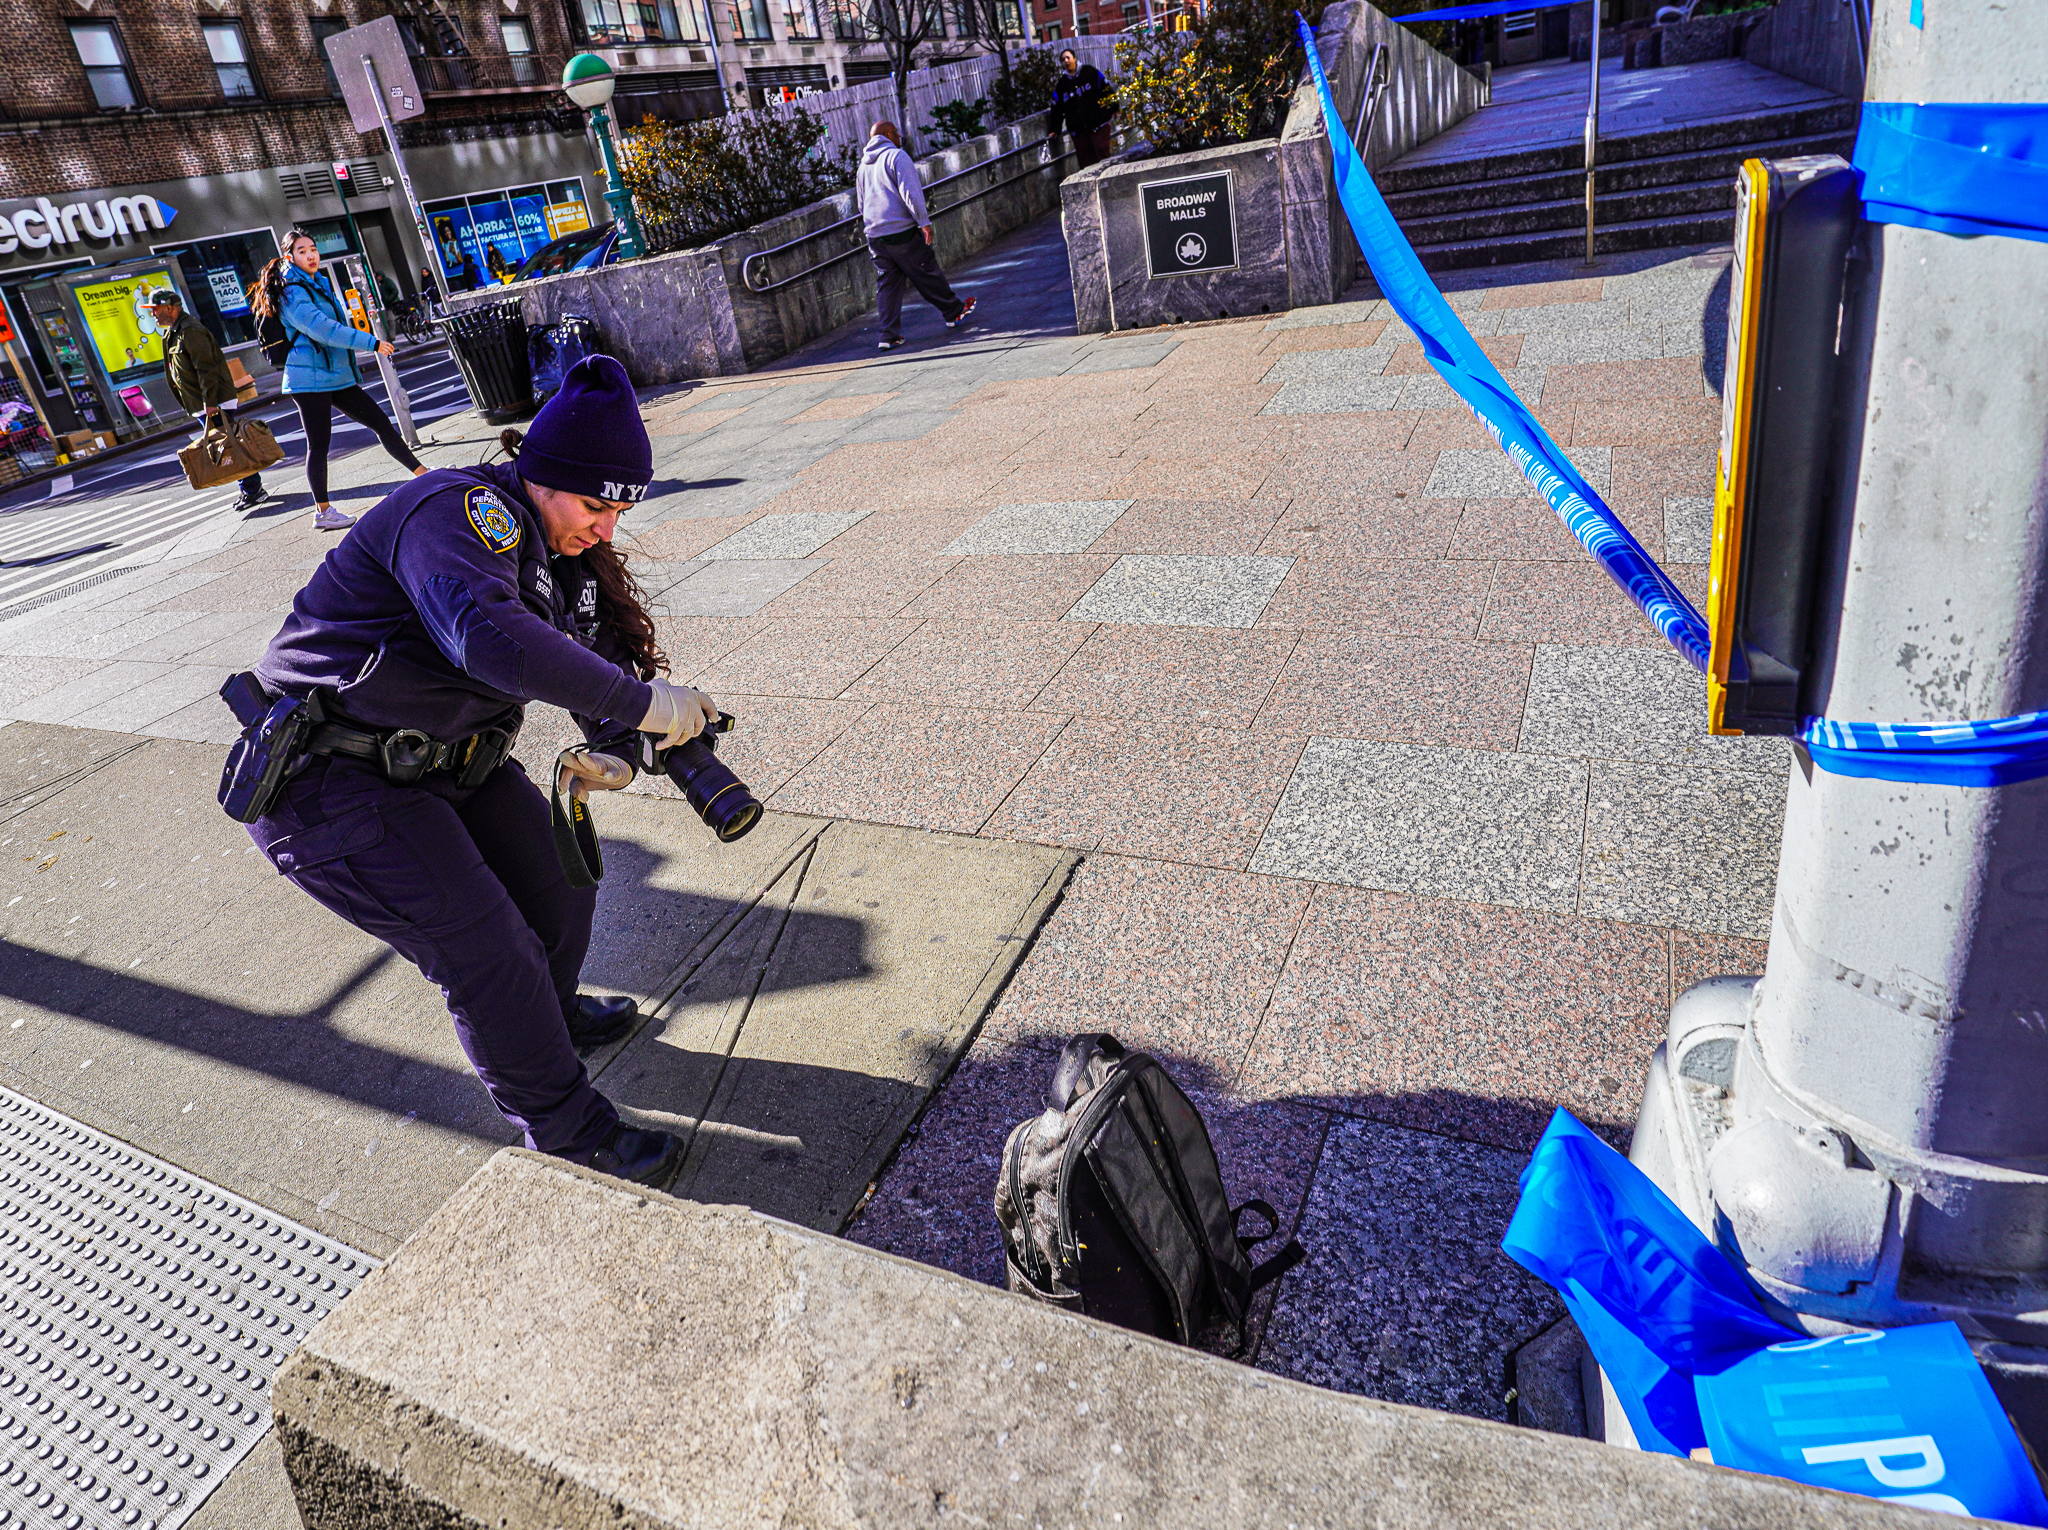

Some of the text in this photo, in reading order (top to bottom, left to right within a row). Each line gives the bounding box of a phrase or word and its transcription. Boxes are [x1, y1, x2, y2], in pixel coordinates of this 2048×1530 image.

[1156, 191, 1217, 210] BROADWAY
[517, 212, 541, 227] 60%
[1169, 207, 1207, 222] MALLS
[481, 232, 509, 244] FACTURA
[210, 274, 236, 287] SAVE
[82, 285, 132, 302] Dream big.
[600, 481, 648, 501] NY
[471, 509, 492, 538] CITY OF
